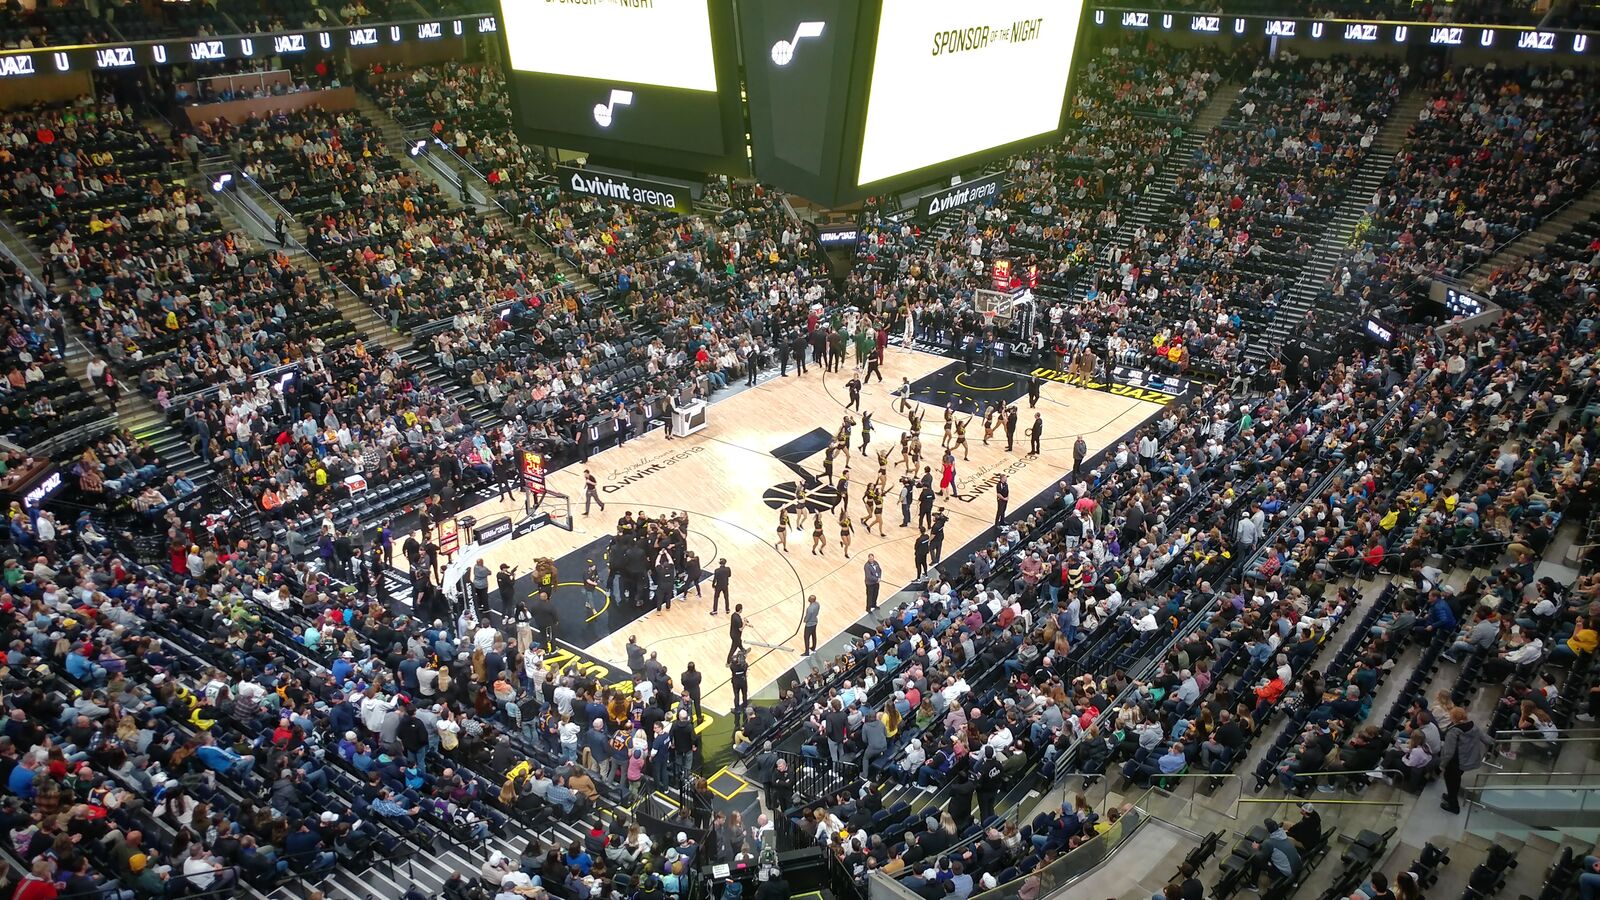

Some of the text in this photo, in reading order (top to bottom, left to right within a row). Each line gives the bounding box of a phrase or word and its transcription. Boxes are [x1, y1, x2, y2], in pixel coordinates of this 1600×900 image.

[54, 52, 70, 71] U
[152, 45, 167, 63] U
[240, 38, 254, 56] U
[319, 32, 331, 49] U
[390, 26, 400, 42] U
[453, 20, 462, 35] U
[932, 18, 1043, 56] SPONSOR OF THE NIGHT
[1095, 10, 1104, 24] U
[1163, 14, 1172, 28] U
[1234, 18, 1245, 33] U
[1312, 22, 1323, 38] U
[1395, 26, 1407, 42] U
[1480, 29, 1494, 46] U
[1573, 34, 1587, 51] U
[586, 176, 676, 208] vivint arena
[940, 182, 996, 211] vivint arena
[1109, 383, 1177, 405] JAZZ
[590, 426, 599, 441] U
[644, 405, 653, 419] U
[617, 463, 666, 486] vivint
[662, 446, 705, 466] arena
